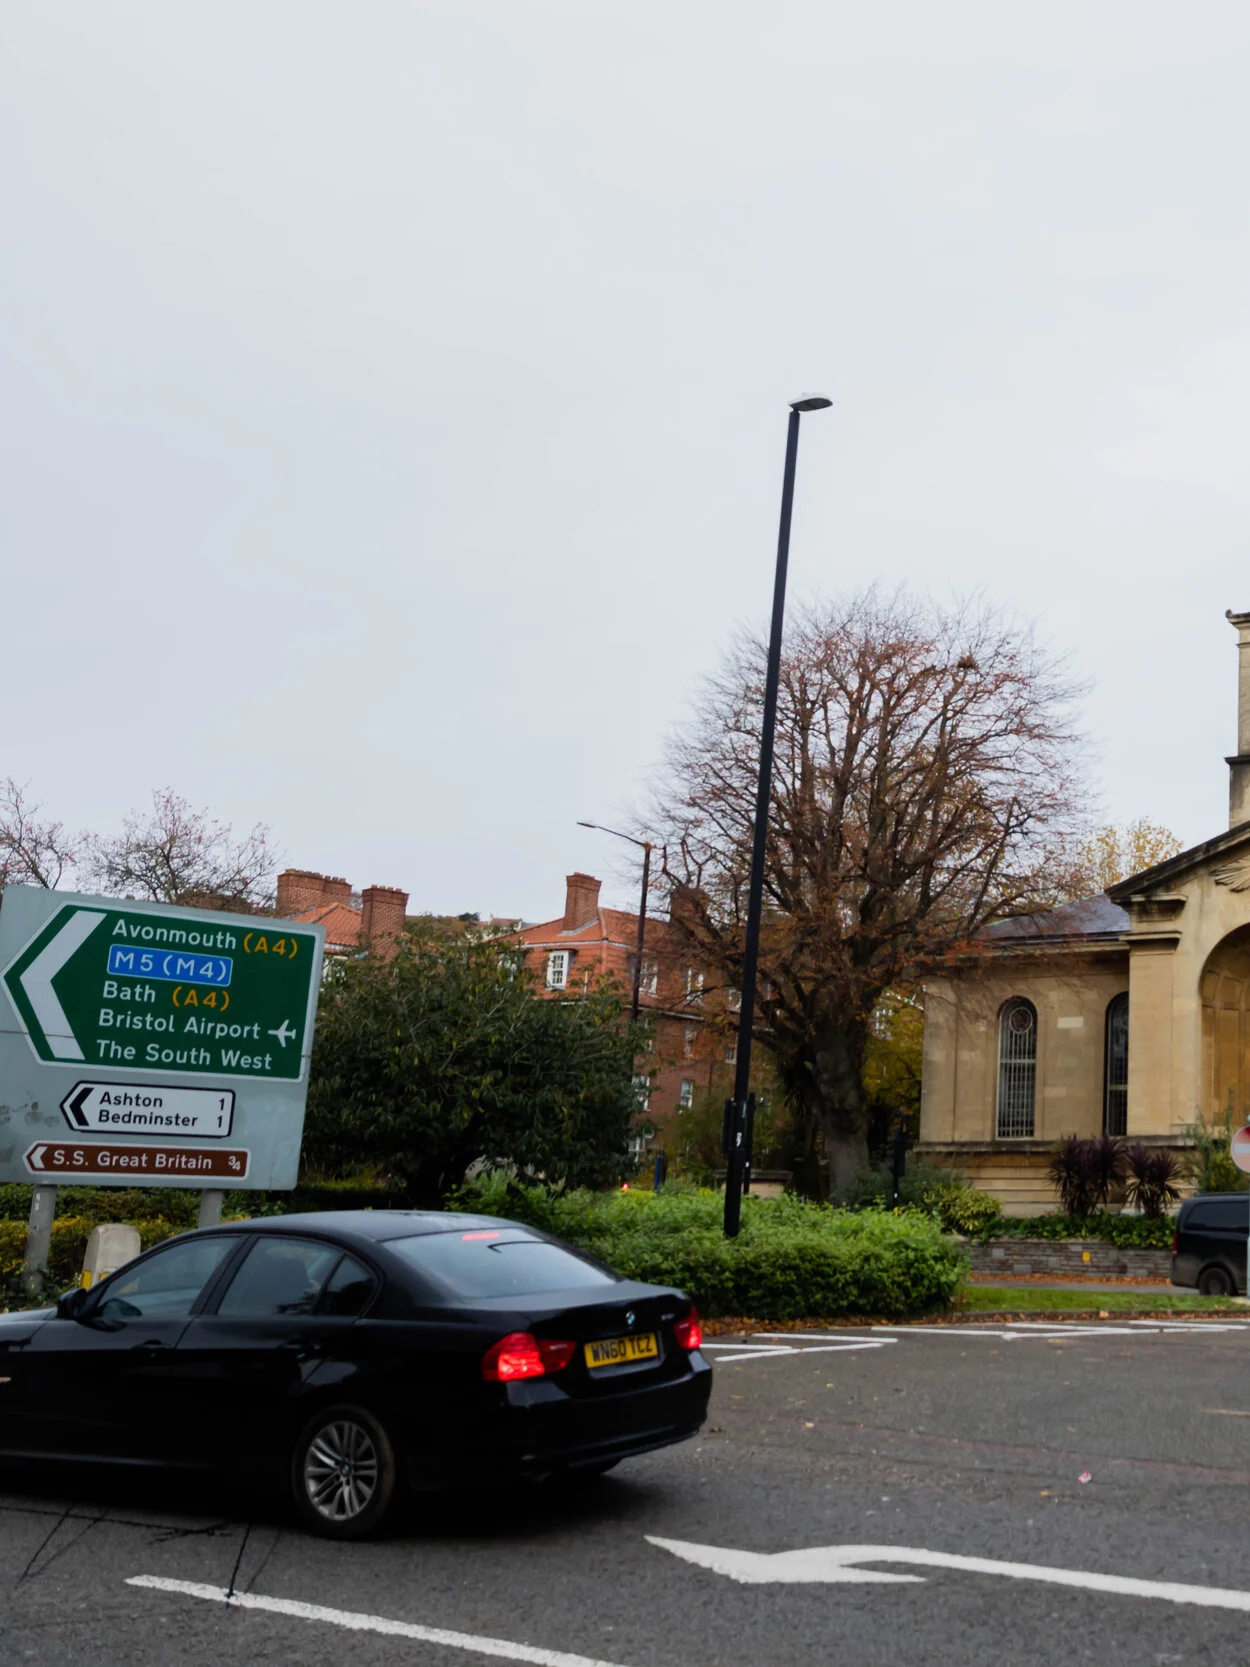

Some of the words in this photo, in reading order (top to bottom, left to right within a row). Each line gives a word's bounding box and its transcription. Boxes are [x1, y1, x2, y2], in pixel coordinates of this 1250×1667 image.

[112, 918, 237, 950] Avonmouth
[243, 932, 298, 959] (A4)
[114, 951, 154, 972] M5
[163, 955, 227, 982] (M4)
[103, 980, 156, 1003] Bath
[172, 986, 230, 1012] (A4)
[98, 1008, 175, 1033] Bristol
[184, 1016, 261, 1039] Airport
[96, 1039, 136, 1060] The
[145, 1043, 211, 1065] South
[220, 1049, 273, 1070] West
[99, 1091, 163, 1108] Ashton
[218, 1098, 225, 1111] 1
[98, 1109, 198, 1127] Bedminster
[216, 1115, 223, 1128] 1
[52, 1149, 89, 1166] S.S.
[97, 1151, 148, 1168] Great
[155, 1153, 212, 1170] Britain
